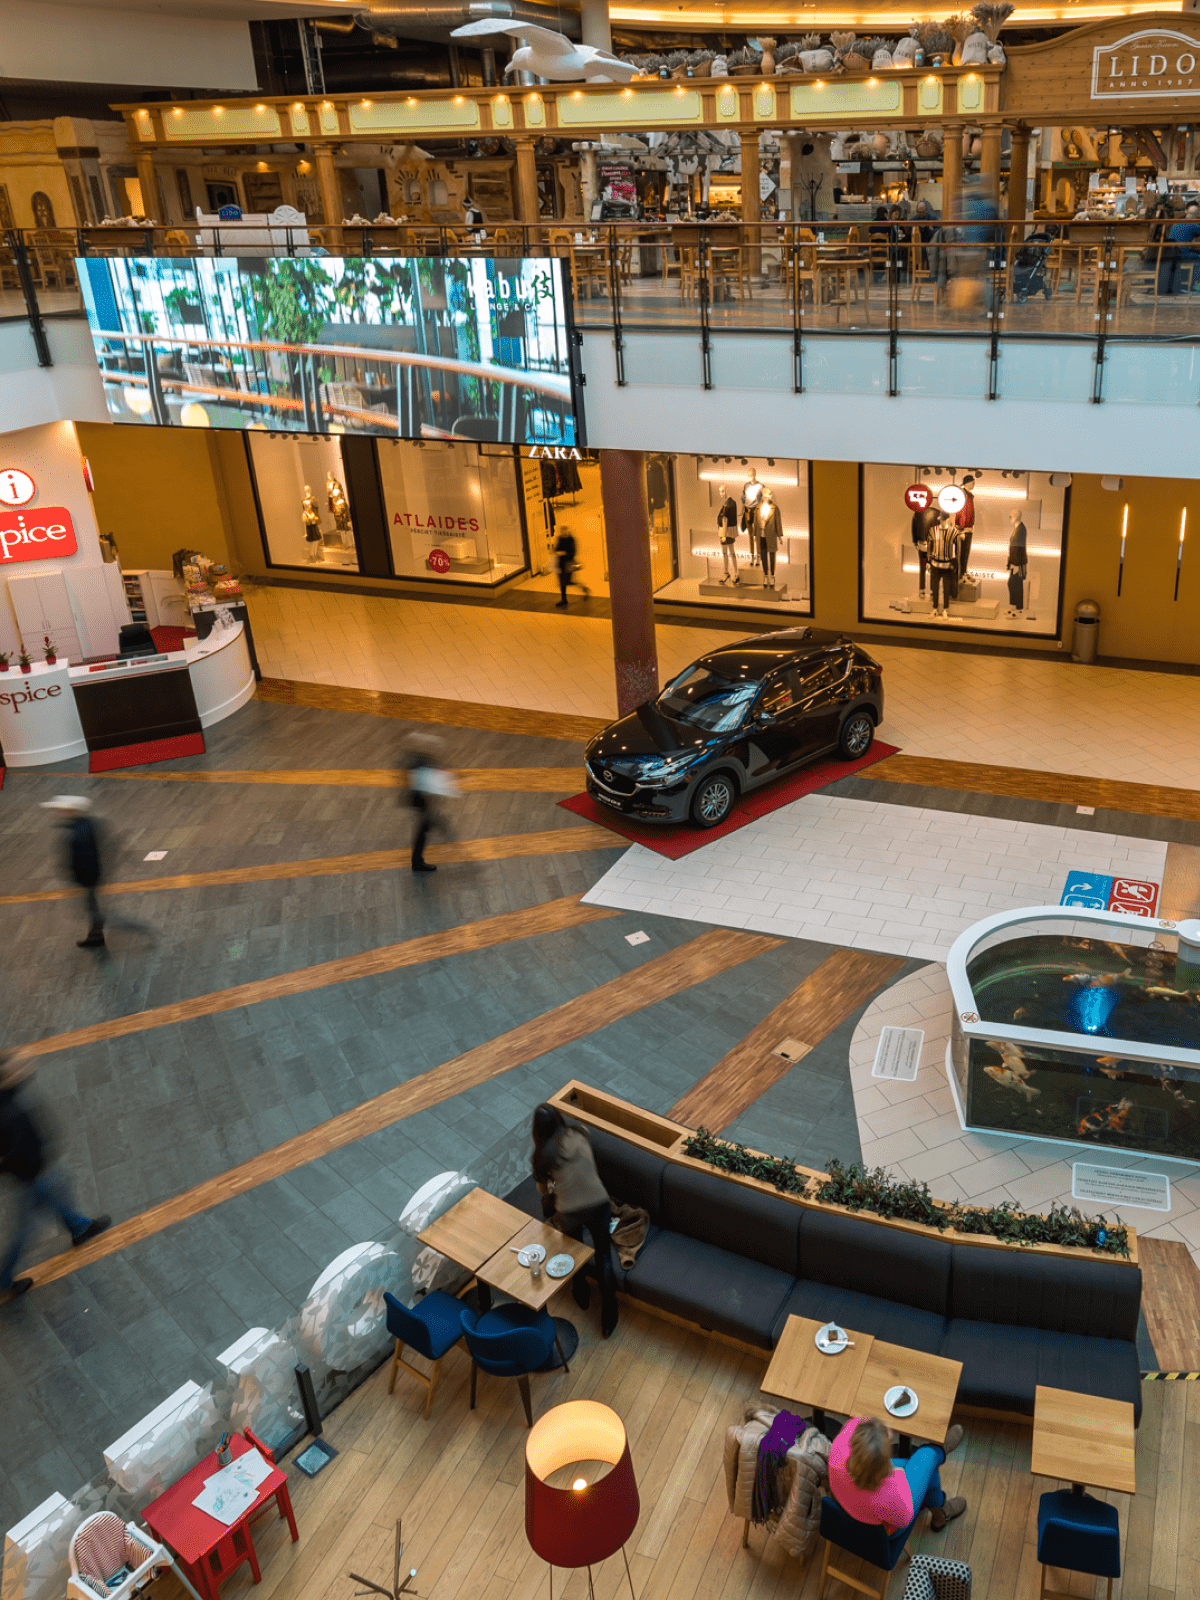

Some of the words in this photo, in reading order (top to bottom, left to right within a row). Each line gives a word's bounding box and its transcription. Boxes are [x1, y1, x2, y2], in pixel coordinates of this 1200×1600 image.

[1109, 53, 1196, 77] LIDO
[1109, 80, 1148, 88] ANNO
[528, 445, 582, 460] ZARA
[393, 512, 480, 531] ATLAIDES
[0, 515, 67, 559] pice
[0, 681, 62, 714] spice
